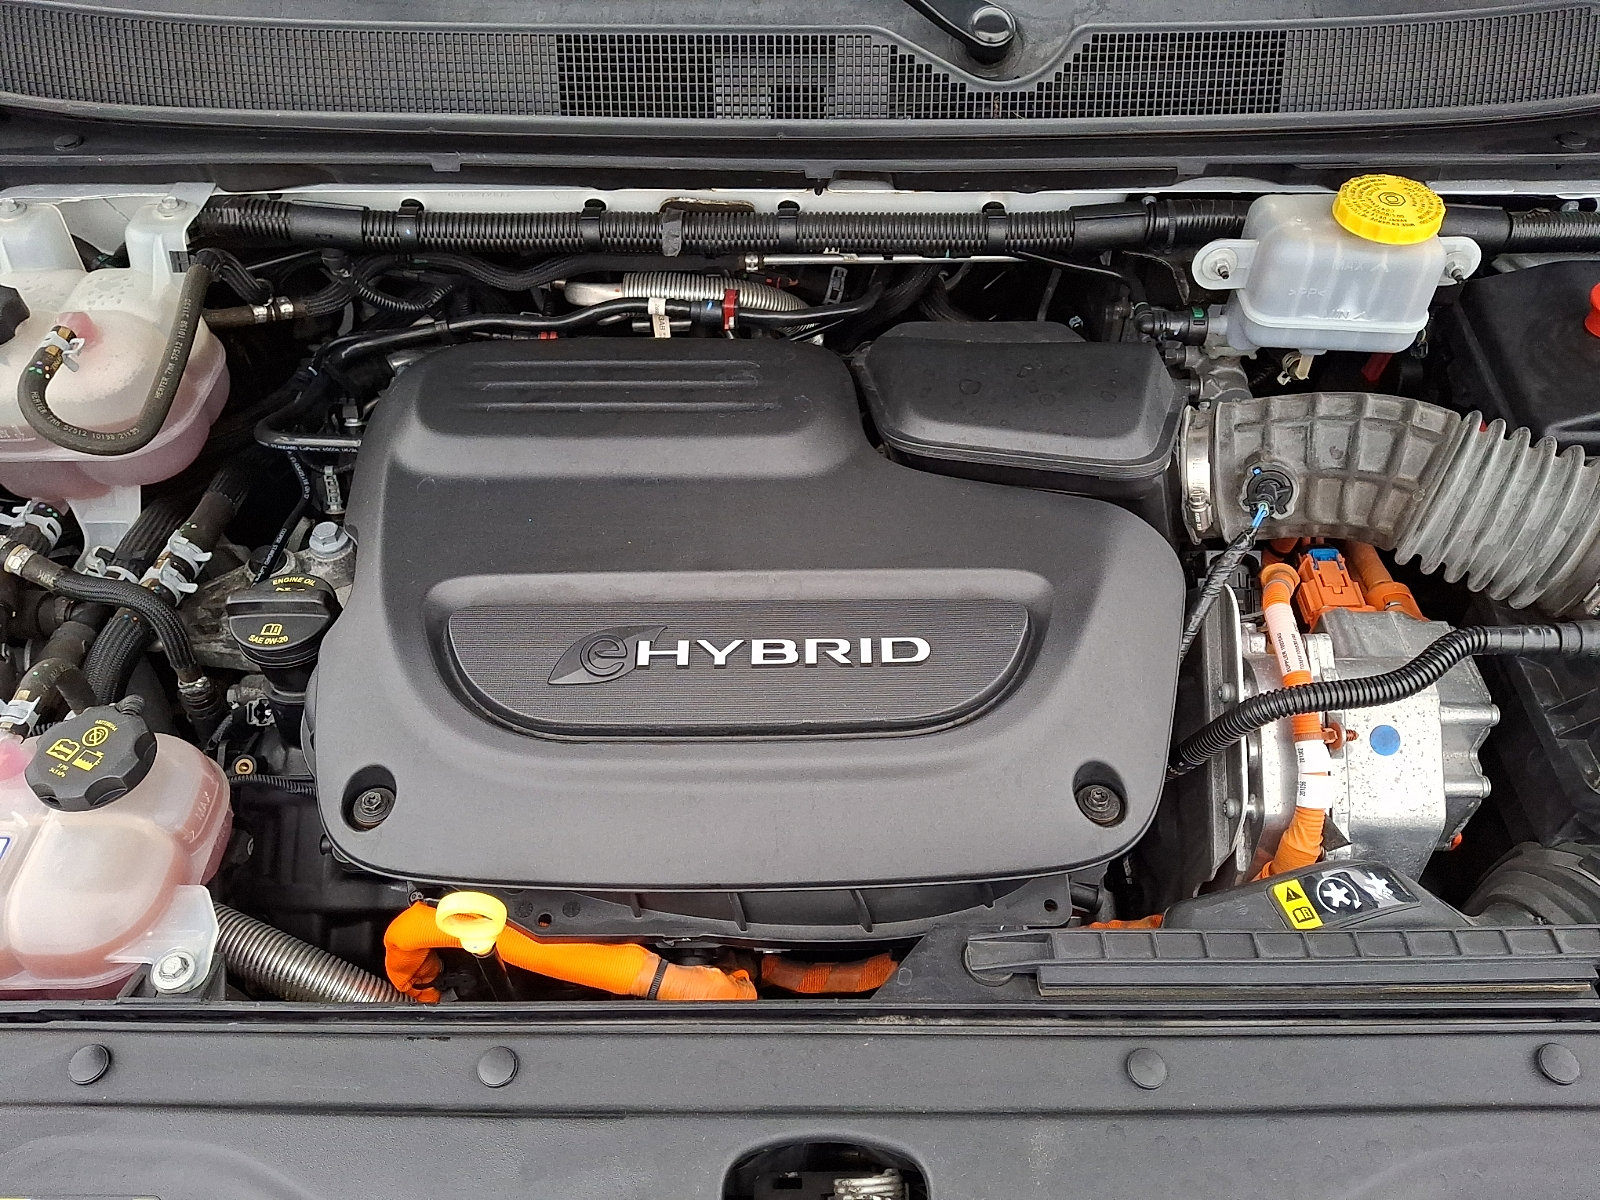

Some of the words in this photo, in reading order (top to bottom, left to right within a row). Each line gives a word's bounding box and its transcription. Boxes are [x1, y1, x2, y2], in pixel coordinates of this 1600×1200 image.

[272, 576, 303, 586] ENGINE
[303, 578, 316, 587] OIL
[248, 634, 263, 644] SAE
[264, 635, 289, 645] 0W-20
